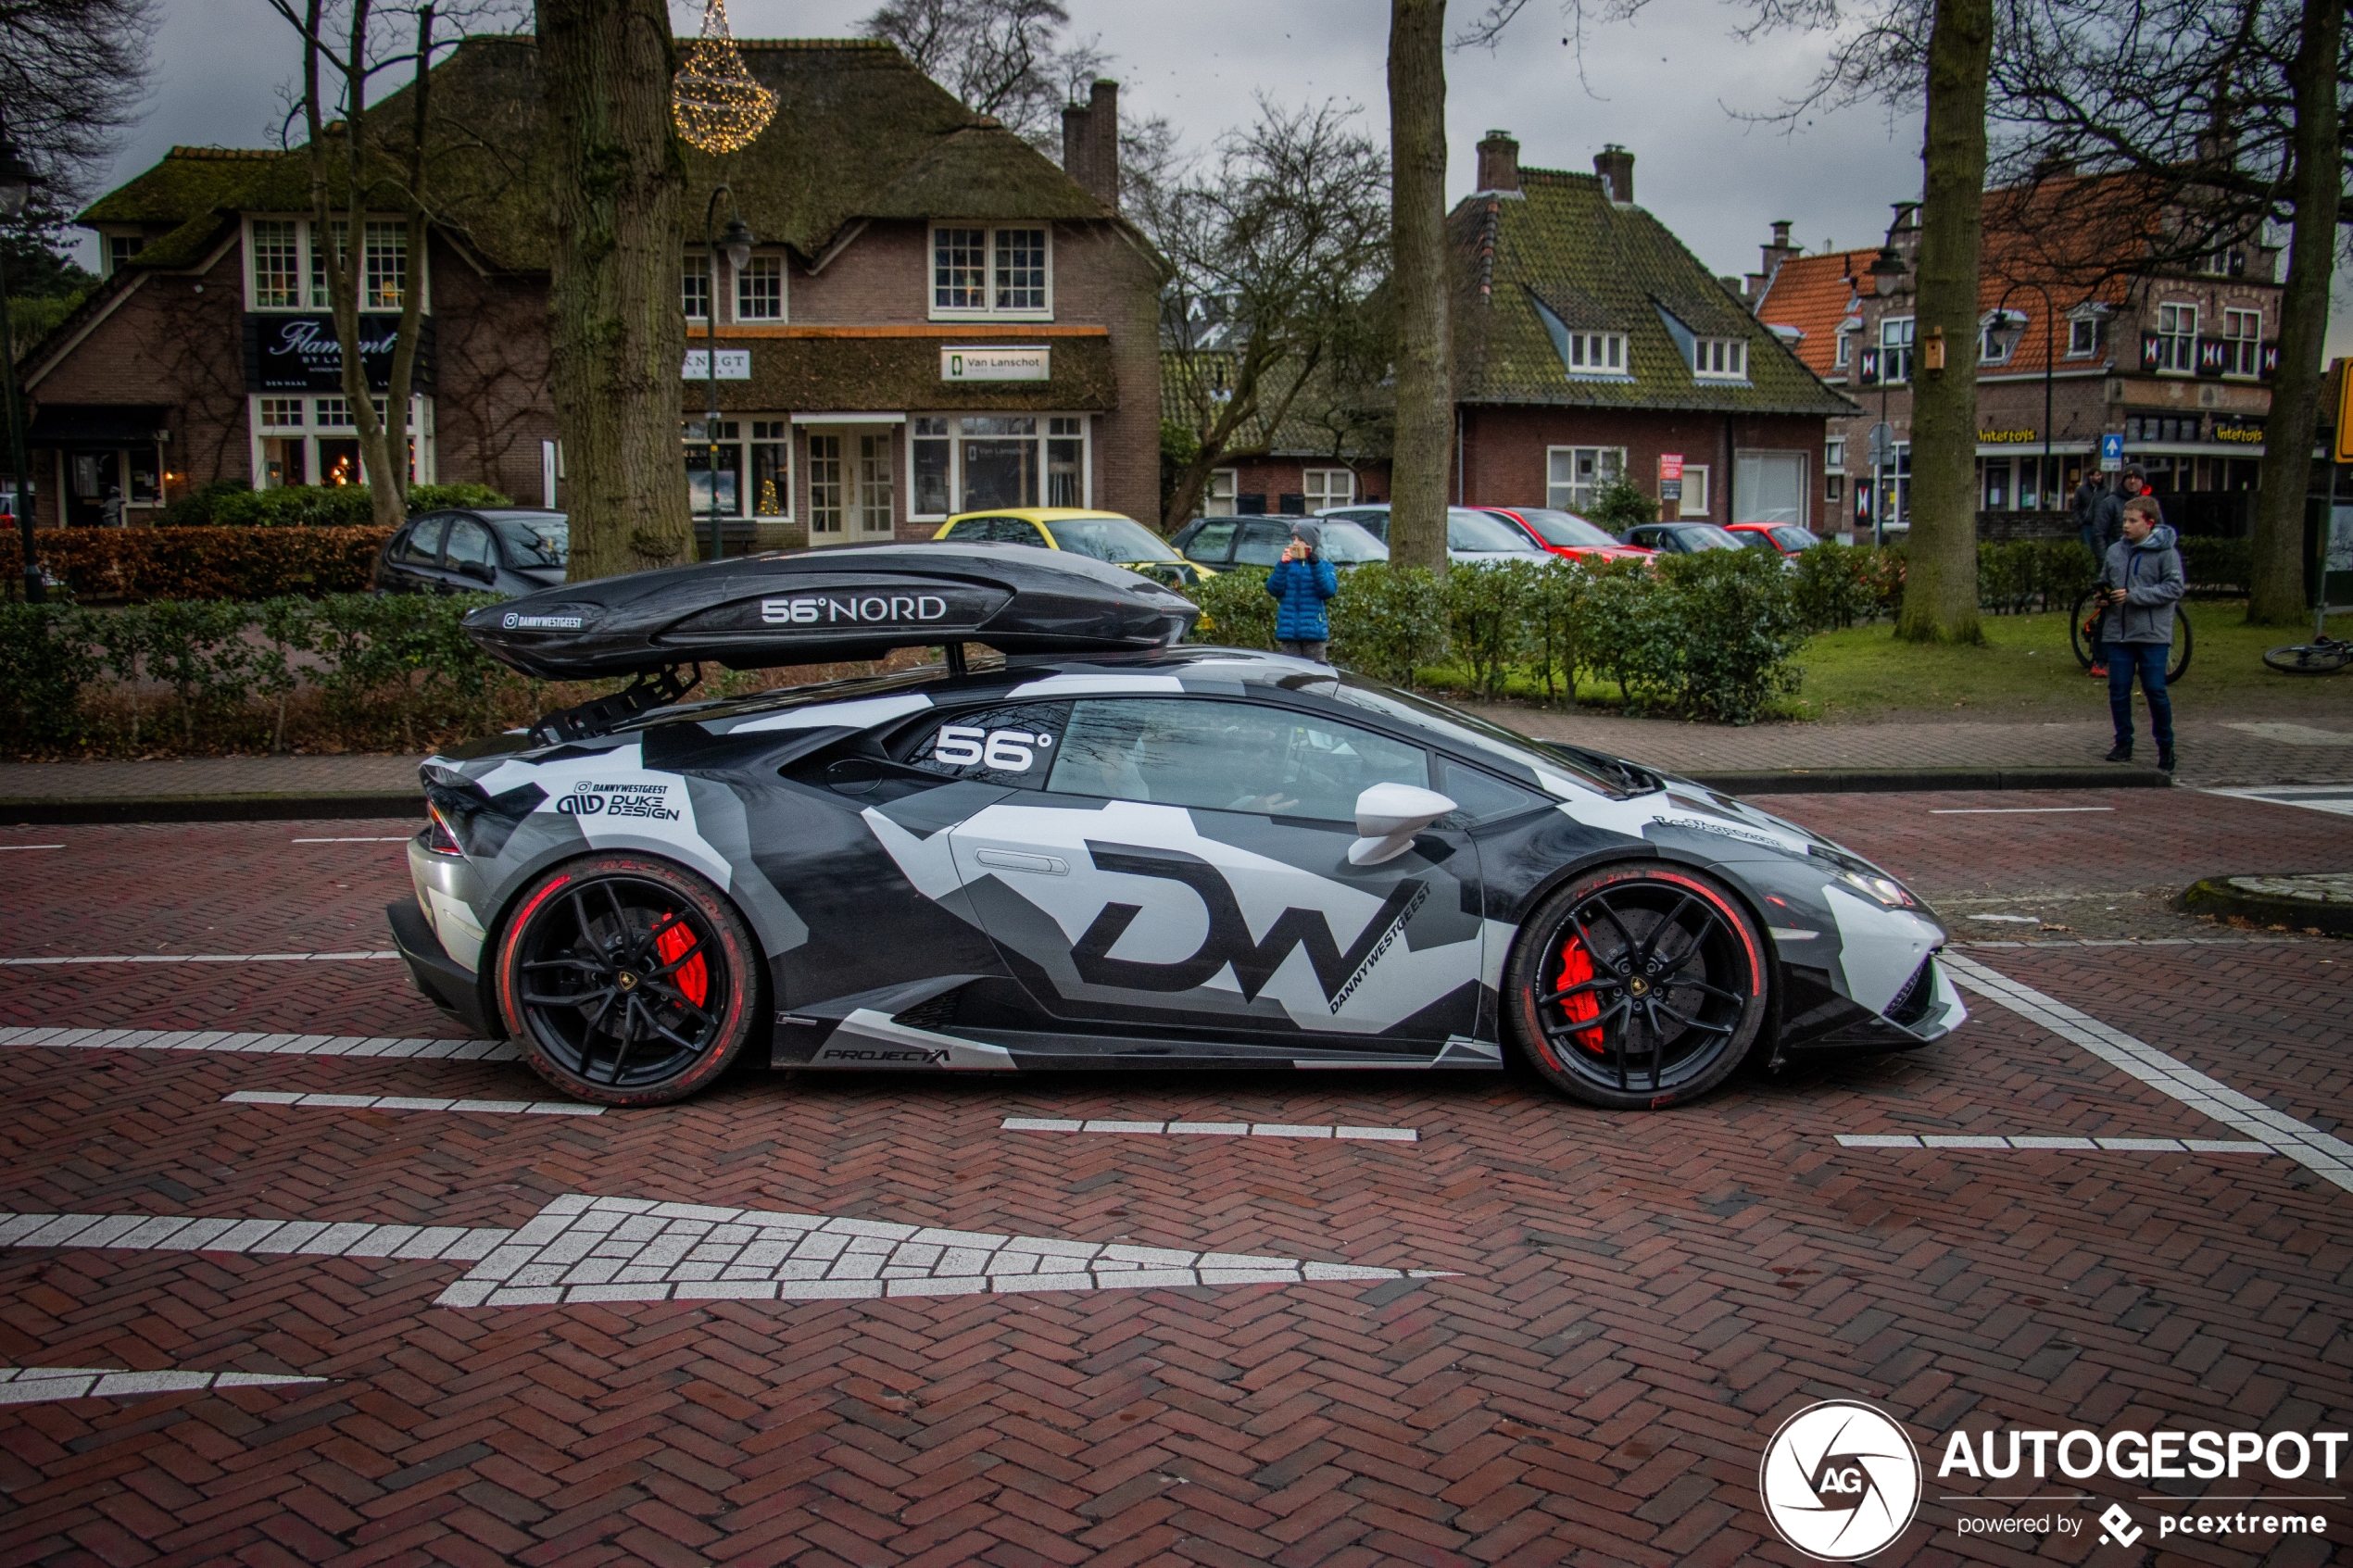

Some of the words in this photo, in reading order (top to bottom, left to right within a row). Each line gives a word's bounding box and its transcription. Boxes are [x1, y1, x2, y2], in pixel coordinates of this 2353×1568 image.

[268, 320, 398, 356] Flamnt
[967, 358, 988, 367] Van
[991, 358, 1039, 367] Lanschot
[1979, 429, 2035, 443] Intertoys
[2217, 426, 2263, 443] Intertoys
[519, 616, 582, 628] DANNYWESTGEEST
[593, 784, 668, 794] DANNYWESTGEEST
[610, 795, 664, 808] DUKE
[607, 805, 680, 822] DESIGN
[1070, 838, 1428, 1005] DW
[1329, 881, 1431, 1016] DANNYWESTGEEST
